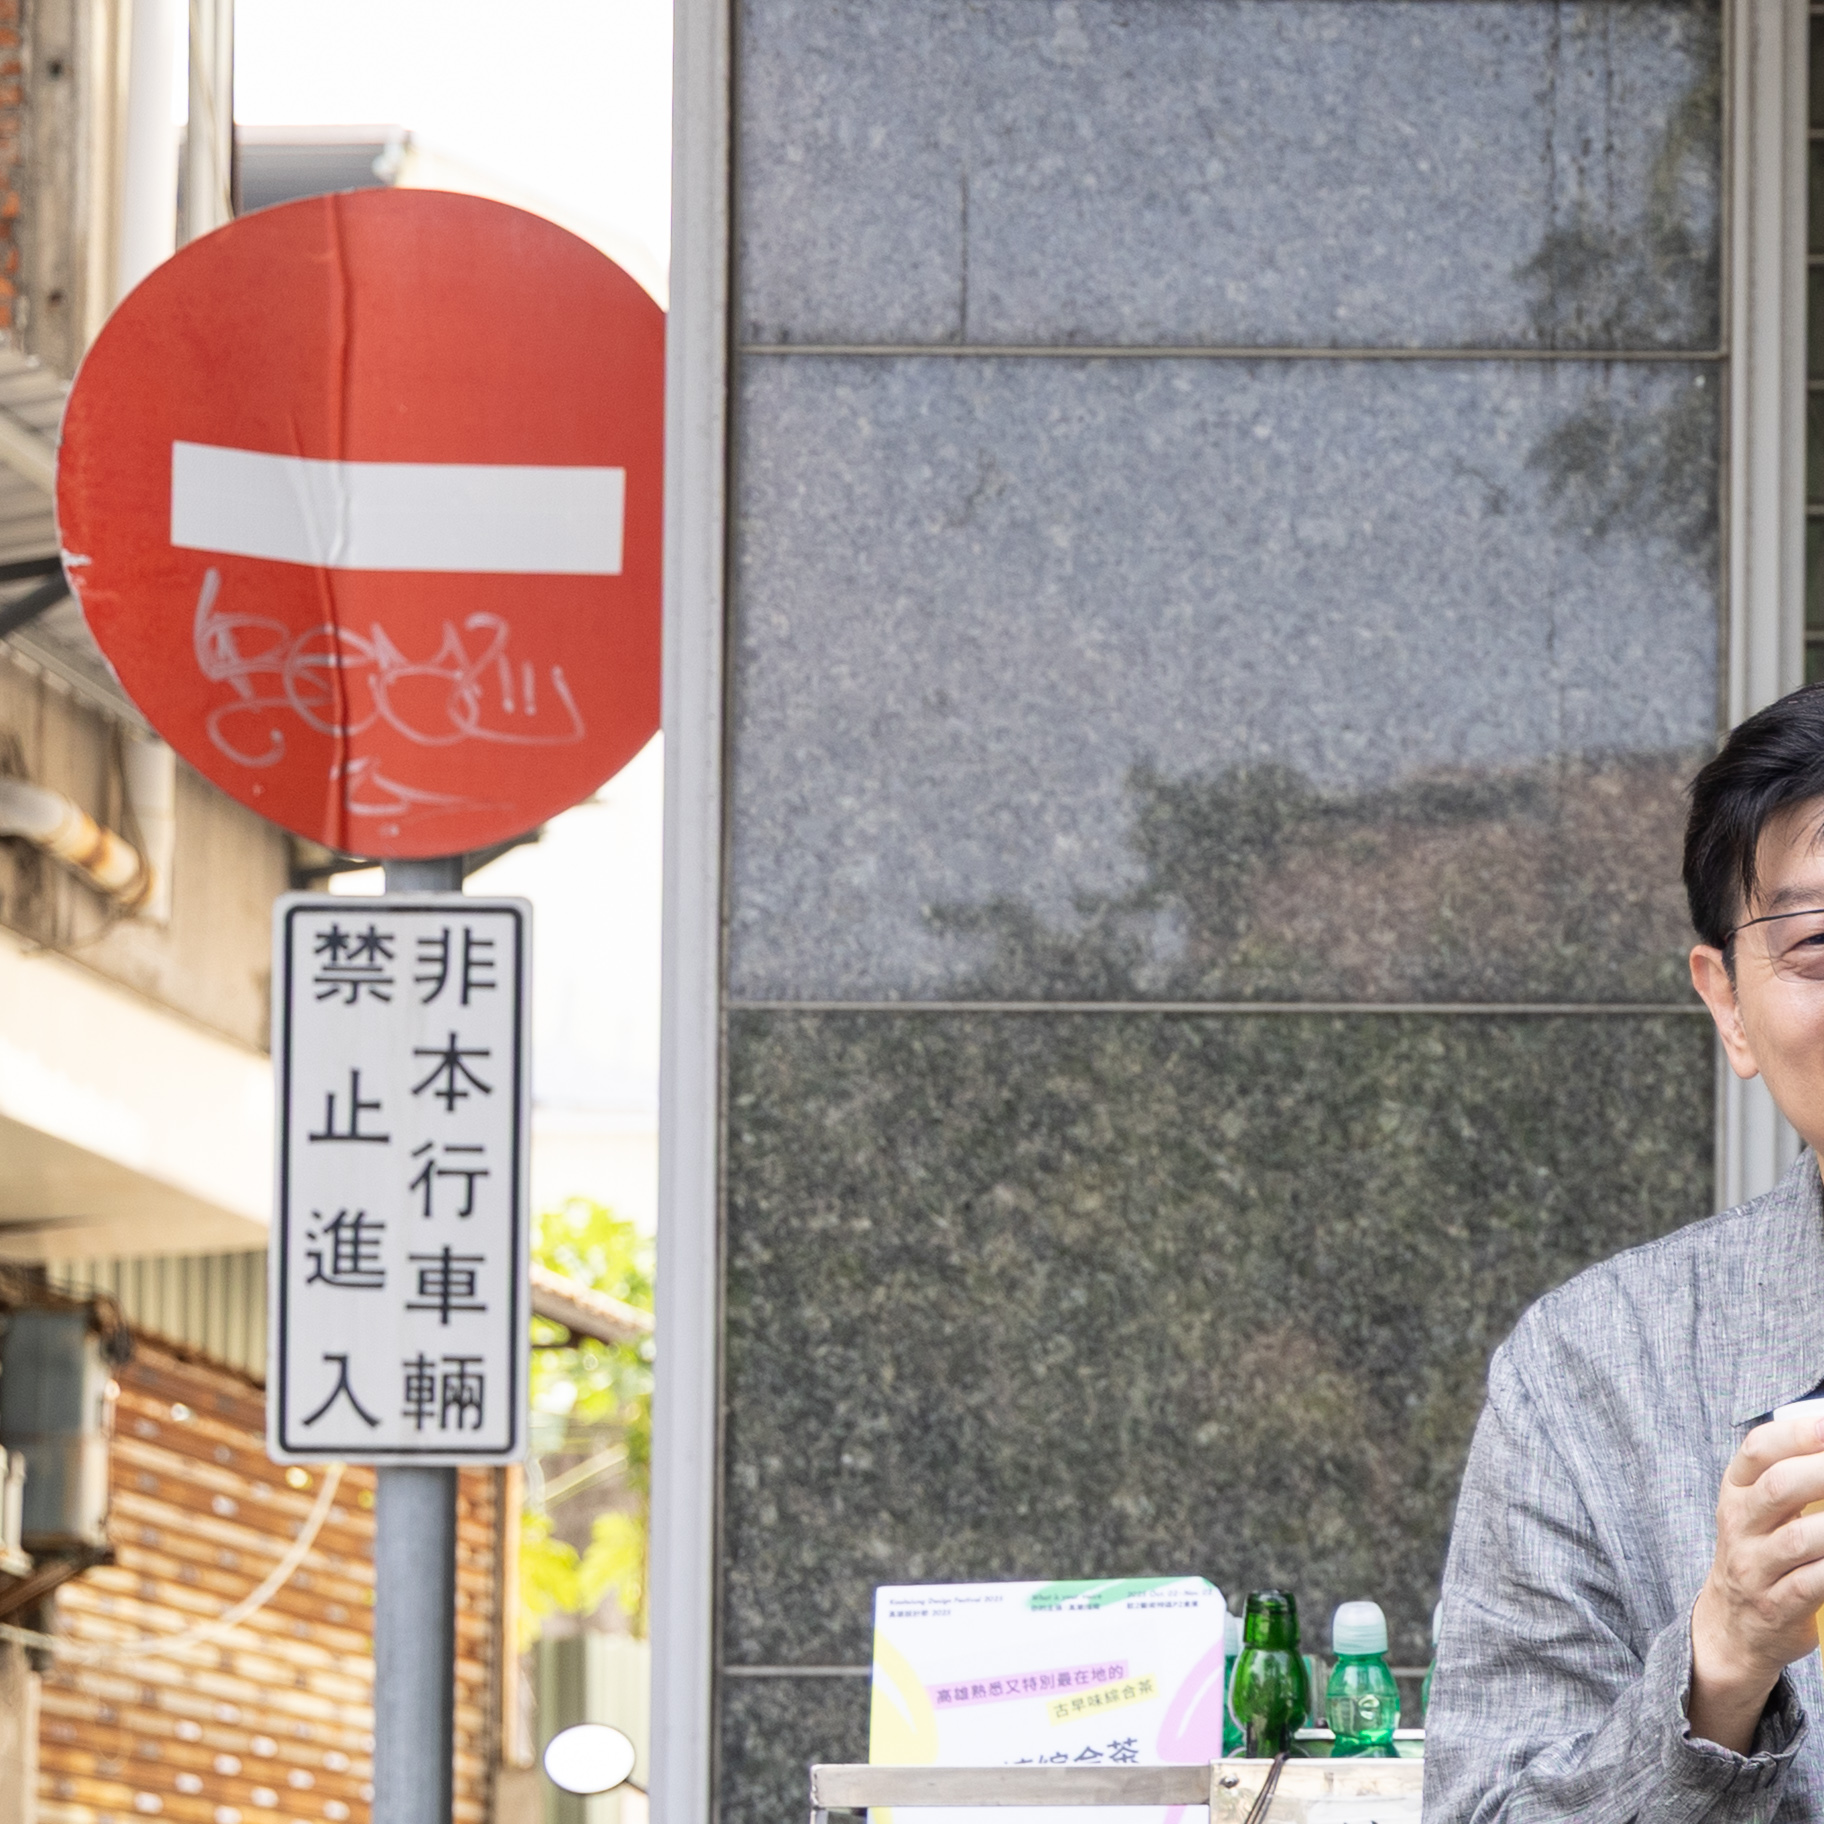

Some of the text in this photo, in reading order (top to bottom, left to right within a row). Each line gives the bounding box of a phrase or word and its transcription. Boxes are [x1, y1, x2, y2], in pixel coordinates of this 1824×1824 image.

[301, 922, 396, 1429] 禁止進入
[401, 925, 498, 1432] 非本行車輛
[936, 1663, 1125, 1706] 高雄熟悉又特別最在地的
[1052, 1677, 1155, 1720] 古早味綜合茶
